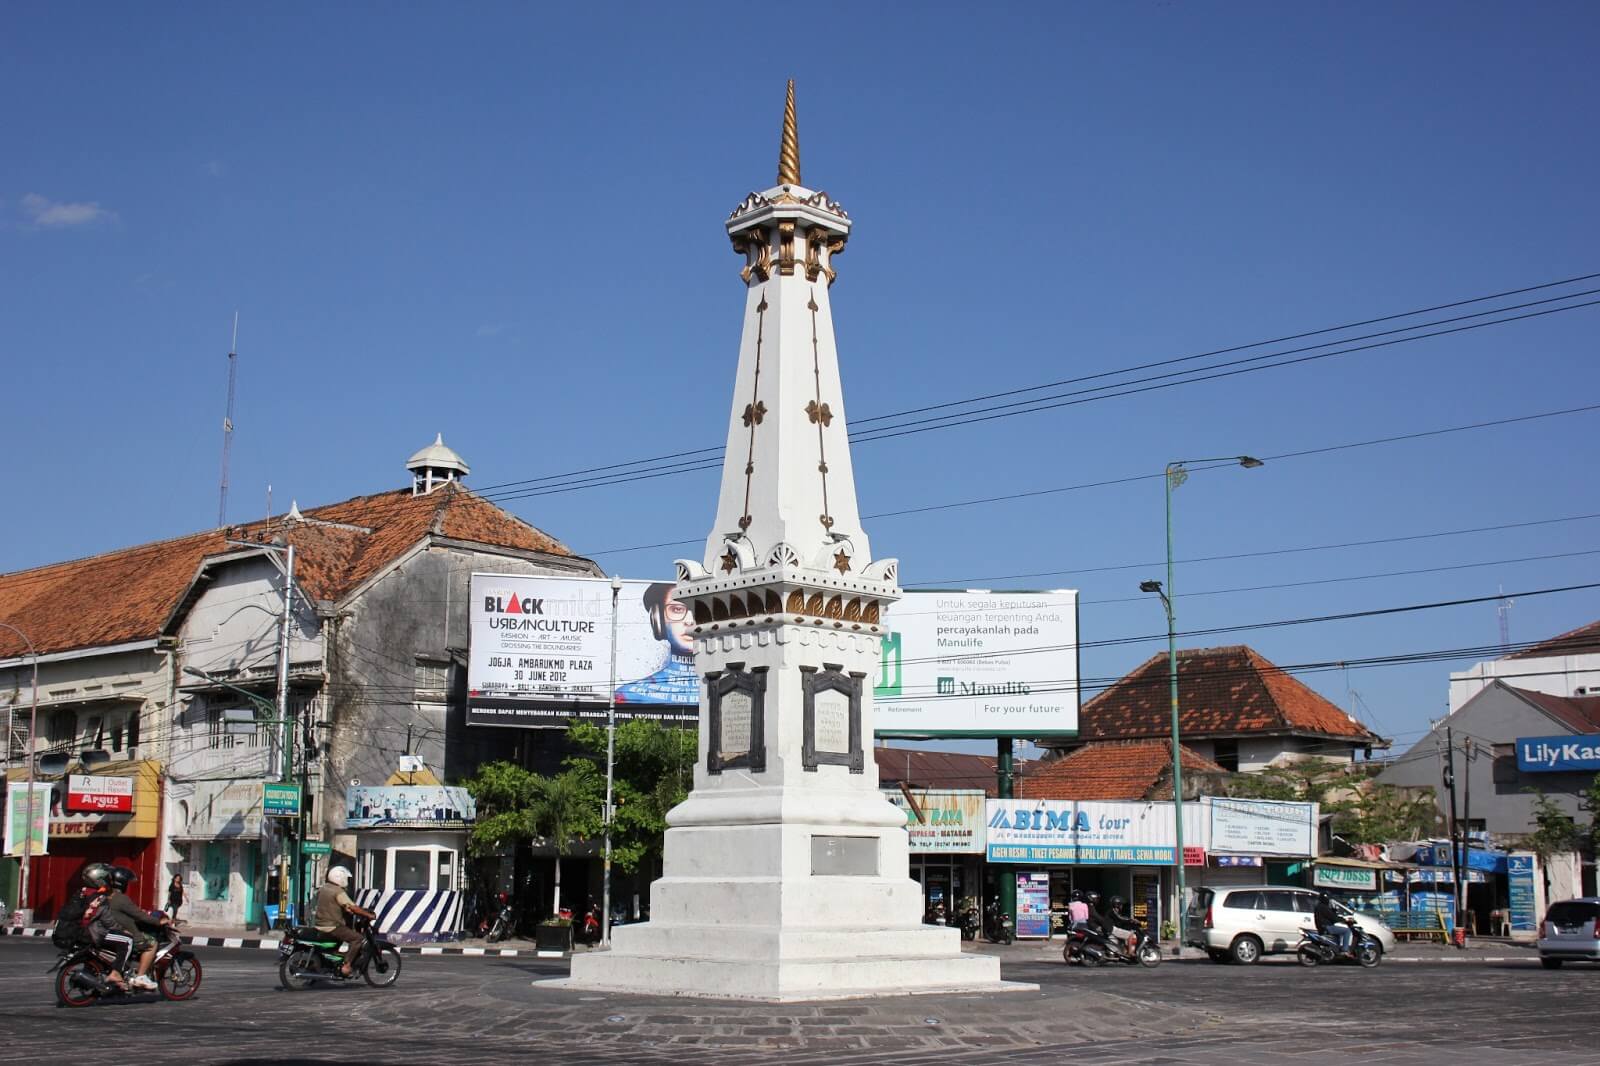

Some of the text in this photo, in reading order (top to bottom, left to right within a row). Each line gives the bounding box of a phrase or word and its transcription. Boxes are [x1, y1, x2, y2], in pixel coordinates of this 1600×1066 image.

[485, 591, 544, 614] BLACK
[936, 599, 1048, 610] Untuk segala keputusan
[936, 611, 1063, 624] keuangan terpenting Anda,
[937, 625, 1039, 637] percayakanlah pada
[937, 638, 984, 647] Manulife
[518, 658, 565, 669] AMBARUKMO
[569, 660, 593, 670] PLAZA
[514, 670, 567, 682] 30 JUNE 2012
[959, 681, 1031, 696] Manulife
[984, 704, 1061, 715] For your future
[81, 794, 119, 808] Argus
[1013, 809, 1130, 831] BIMA tour
[1319, 867, 1341, 880] KOPI
